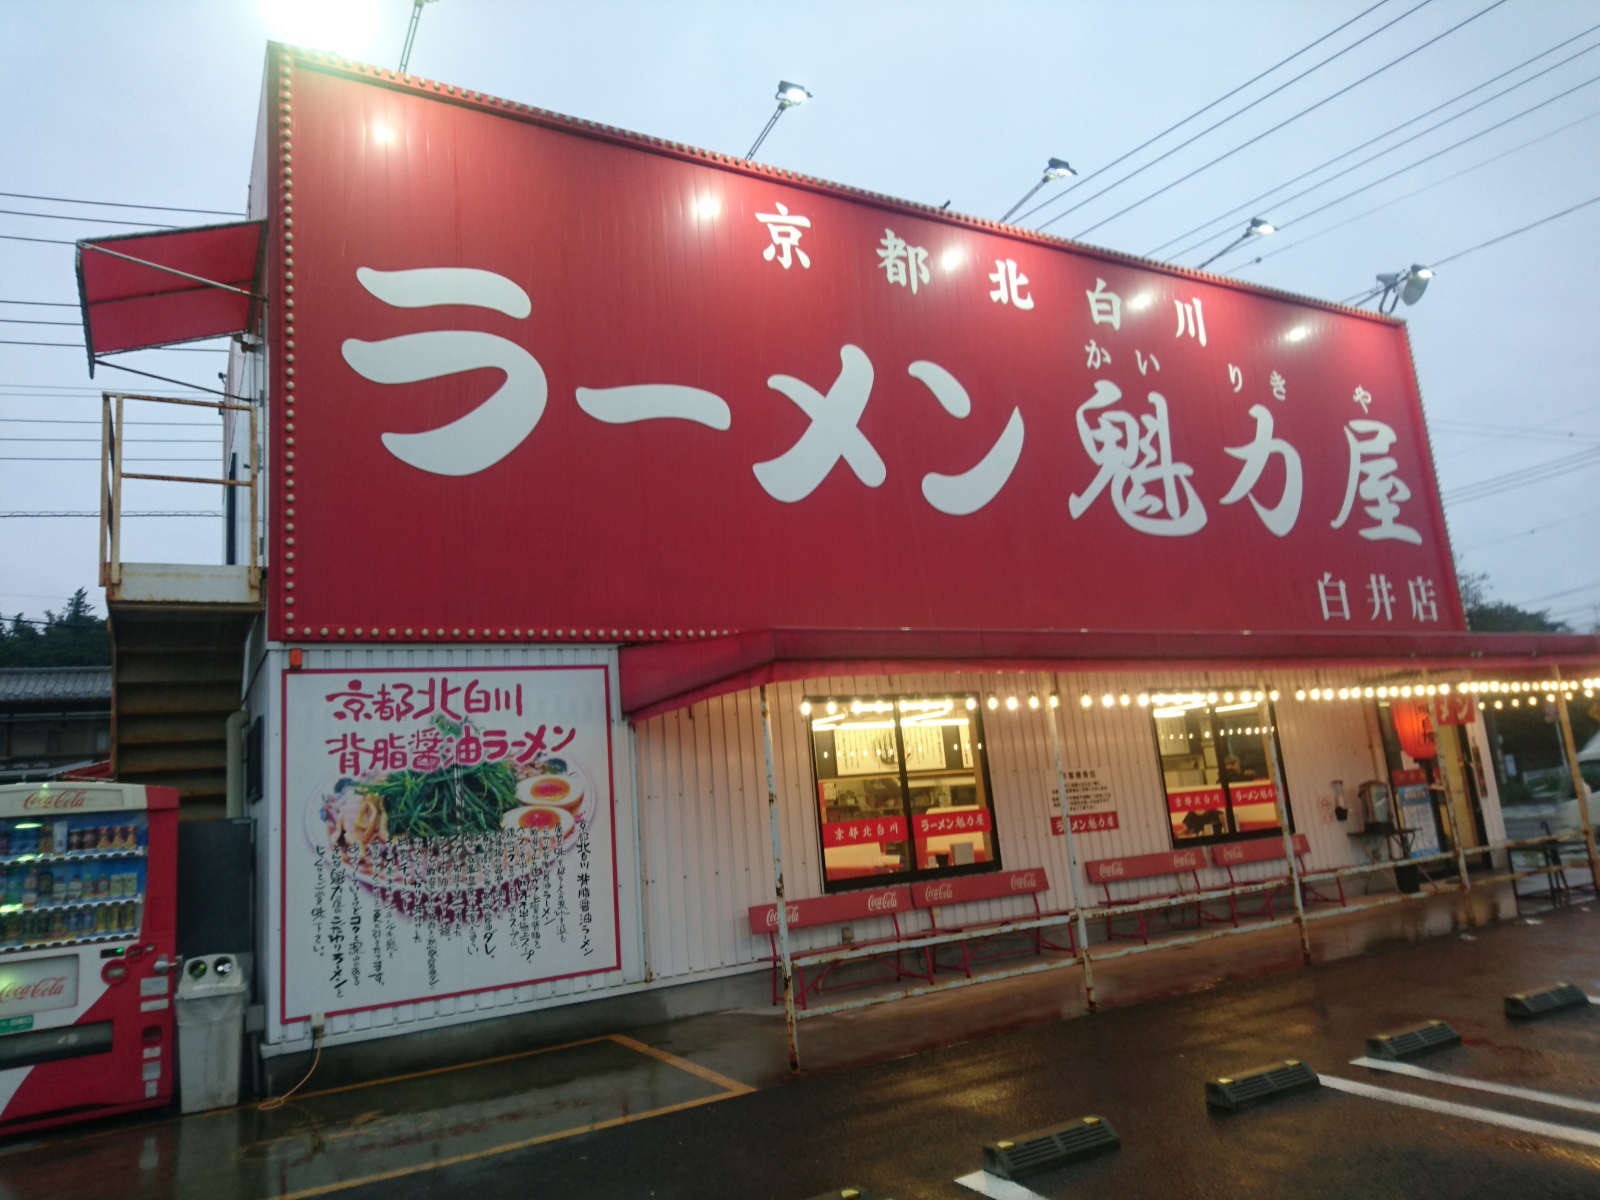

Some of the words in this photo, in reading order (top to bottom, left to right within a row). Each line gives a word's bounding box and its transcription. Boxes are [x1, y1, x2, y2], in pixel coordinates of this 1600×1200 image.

[754, 201, 1208, 348] 京都北白川
[1084, 338, 1373, 415] かいりきや
[341, 266, 1423, 544] ラーメン魁力屋
[1317, 569, 1438, 622] 白井店
[326, 678, 523, 723] 京都北白川
[326, 725, 577, 776] 背脂醤油ラーメン
[1235, 787, 1277, 803] ラーメン魁力
[834, 821, 899, 842] 京都北白川
[920, 813, 985, 832] ラーメン魁力屋
[1056, 814, 1115, 833] ラメン魁力屋
